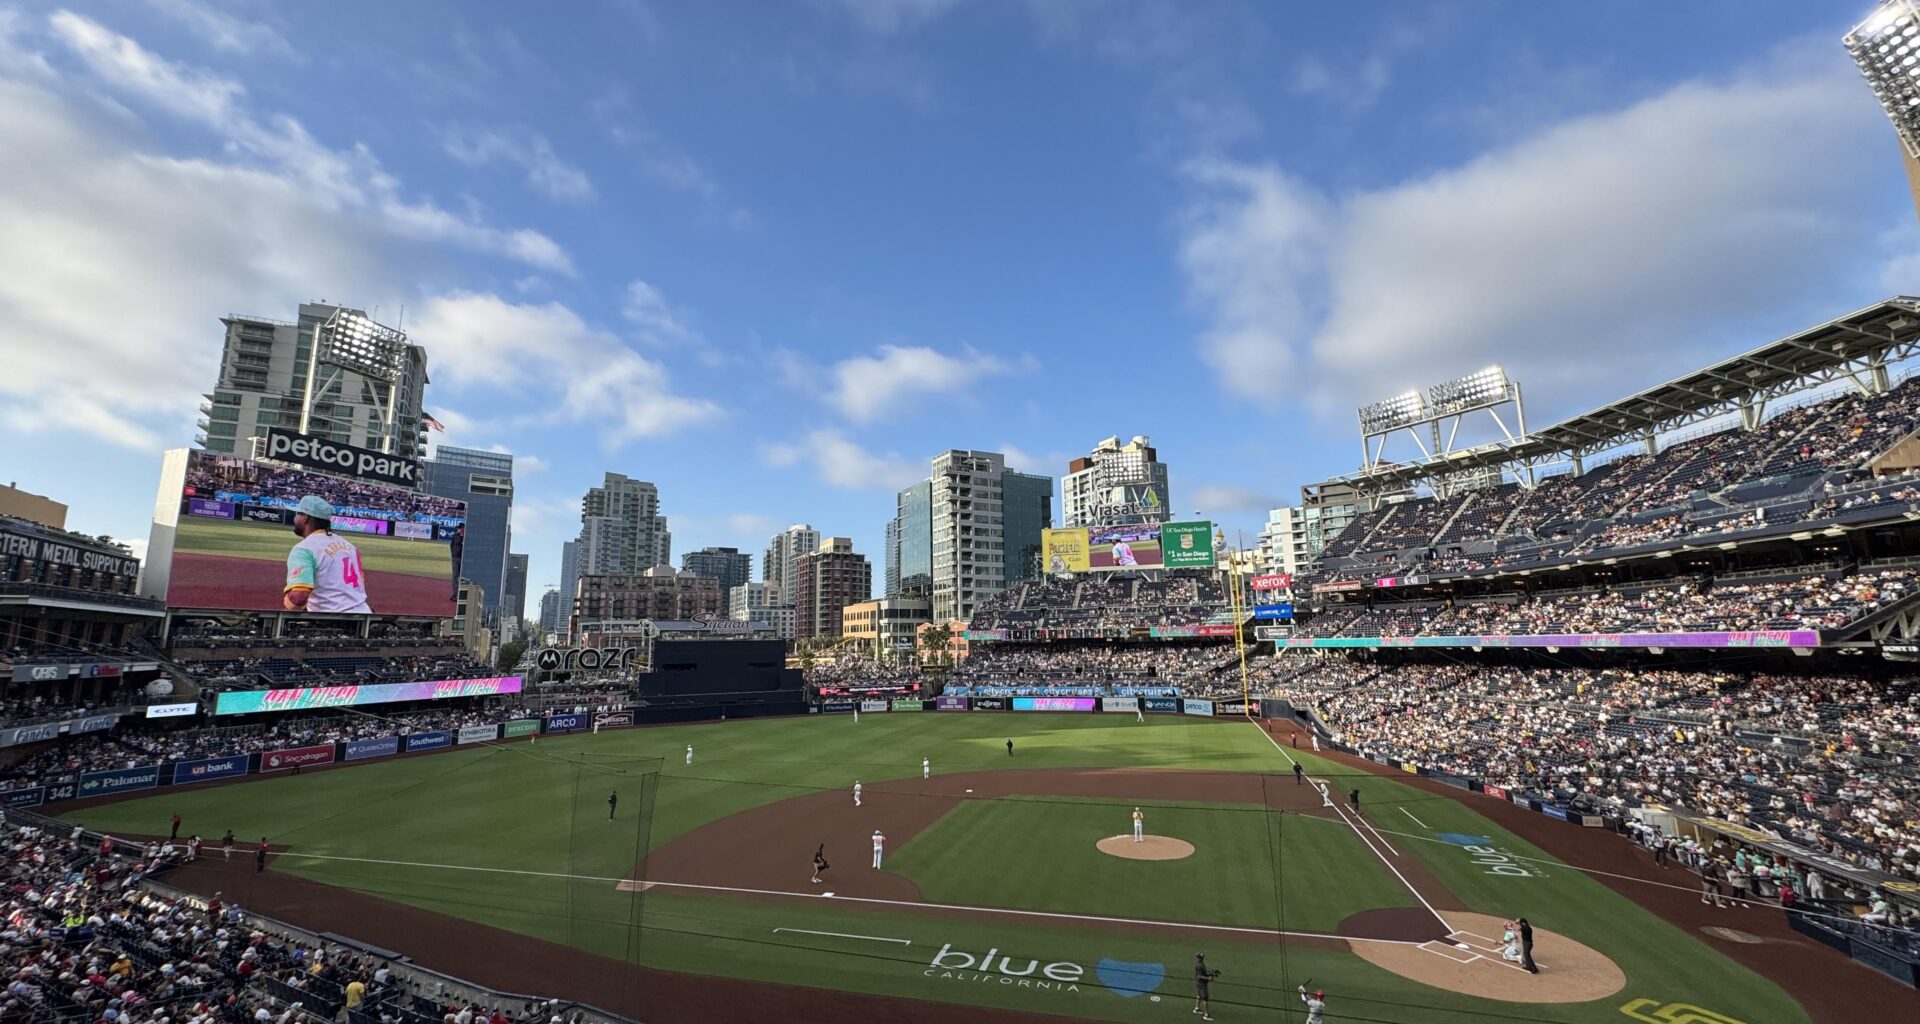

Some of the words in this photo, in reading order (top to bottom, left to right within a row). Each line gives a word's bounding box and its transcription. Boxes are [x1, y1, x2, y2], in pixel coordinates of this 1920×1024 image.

[269, 433, 355, 467] petco
[357, 453, 415, 481] park
[1088, 503, 1137, 517] Viasat
[42, 542, 80, 567] METAL
[82, 552, 121, 574] SUPPLY
[342, 556, 359, 588] 4
[1256, 576, 1286, 588] xerox
[690, 611, 751, 633] Sycuan
[1727, 631, 1752, 647] SAN
[1752, 631, 1790, 647] DIEGO
[564, 648, 637, 670] razr
[432, 680, 464, 699] SAN
[461, 678, 502, 696] DIEGO
[259, 688, 307, 712] SAN
[307, 685, 360, 709] DIEGO
[1185, 702, 1202, 711] petco
[550, 718, 577, 729] ARCO
[594, 713, 630, 728] Sycuan
[460, 727, 497, 738] SYMBIOTIKA
[409, 736, 444, 747] Southwest
[192, 764, 206, 775] us
[207, 760, 234, 773] bank
[101, 774, 156, 788] Palomar
[49, 785, 73, 800] 342
[1463, 845, 1533, 877] blue
[931, 943, 1084, 982] blue
[923, 969, 1080, 993] CALIFORNIA
